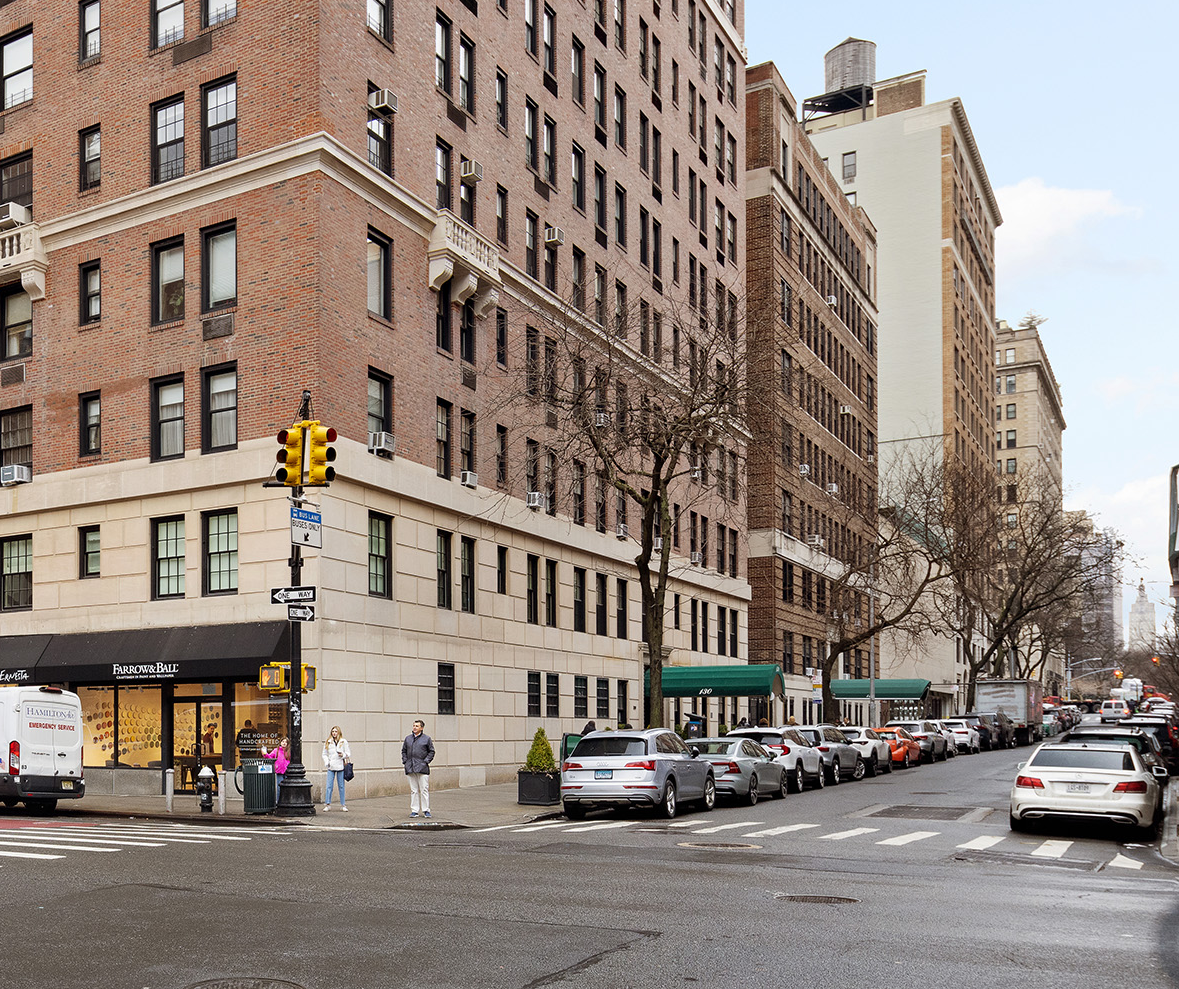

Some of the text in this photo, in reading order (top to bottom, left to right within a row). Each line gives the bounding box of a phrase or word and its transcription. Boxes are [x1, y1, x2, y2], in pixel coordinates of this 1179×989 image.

[298, 511, 320, 522] BUS LANE
[292, 519, 320, 531] BUSES ONLY
[29, 722, 57, 730] EMERGENCY
